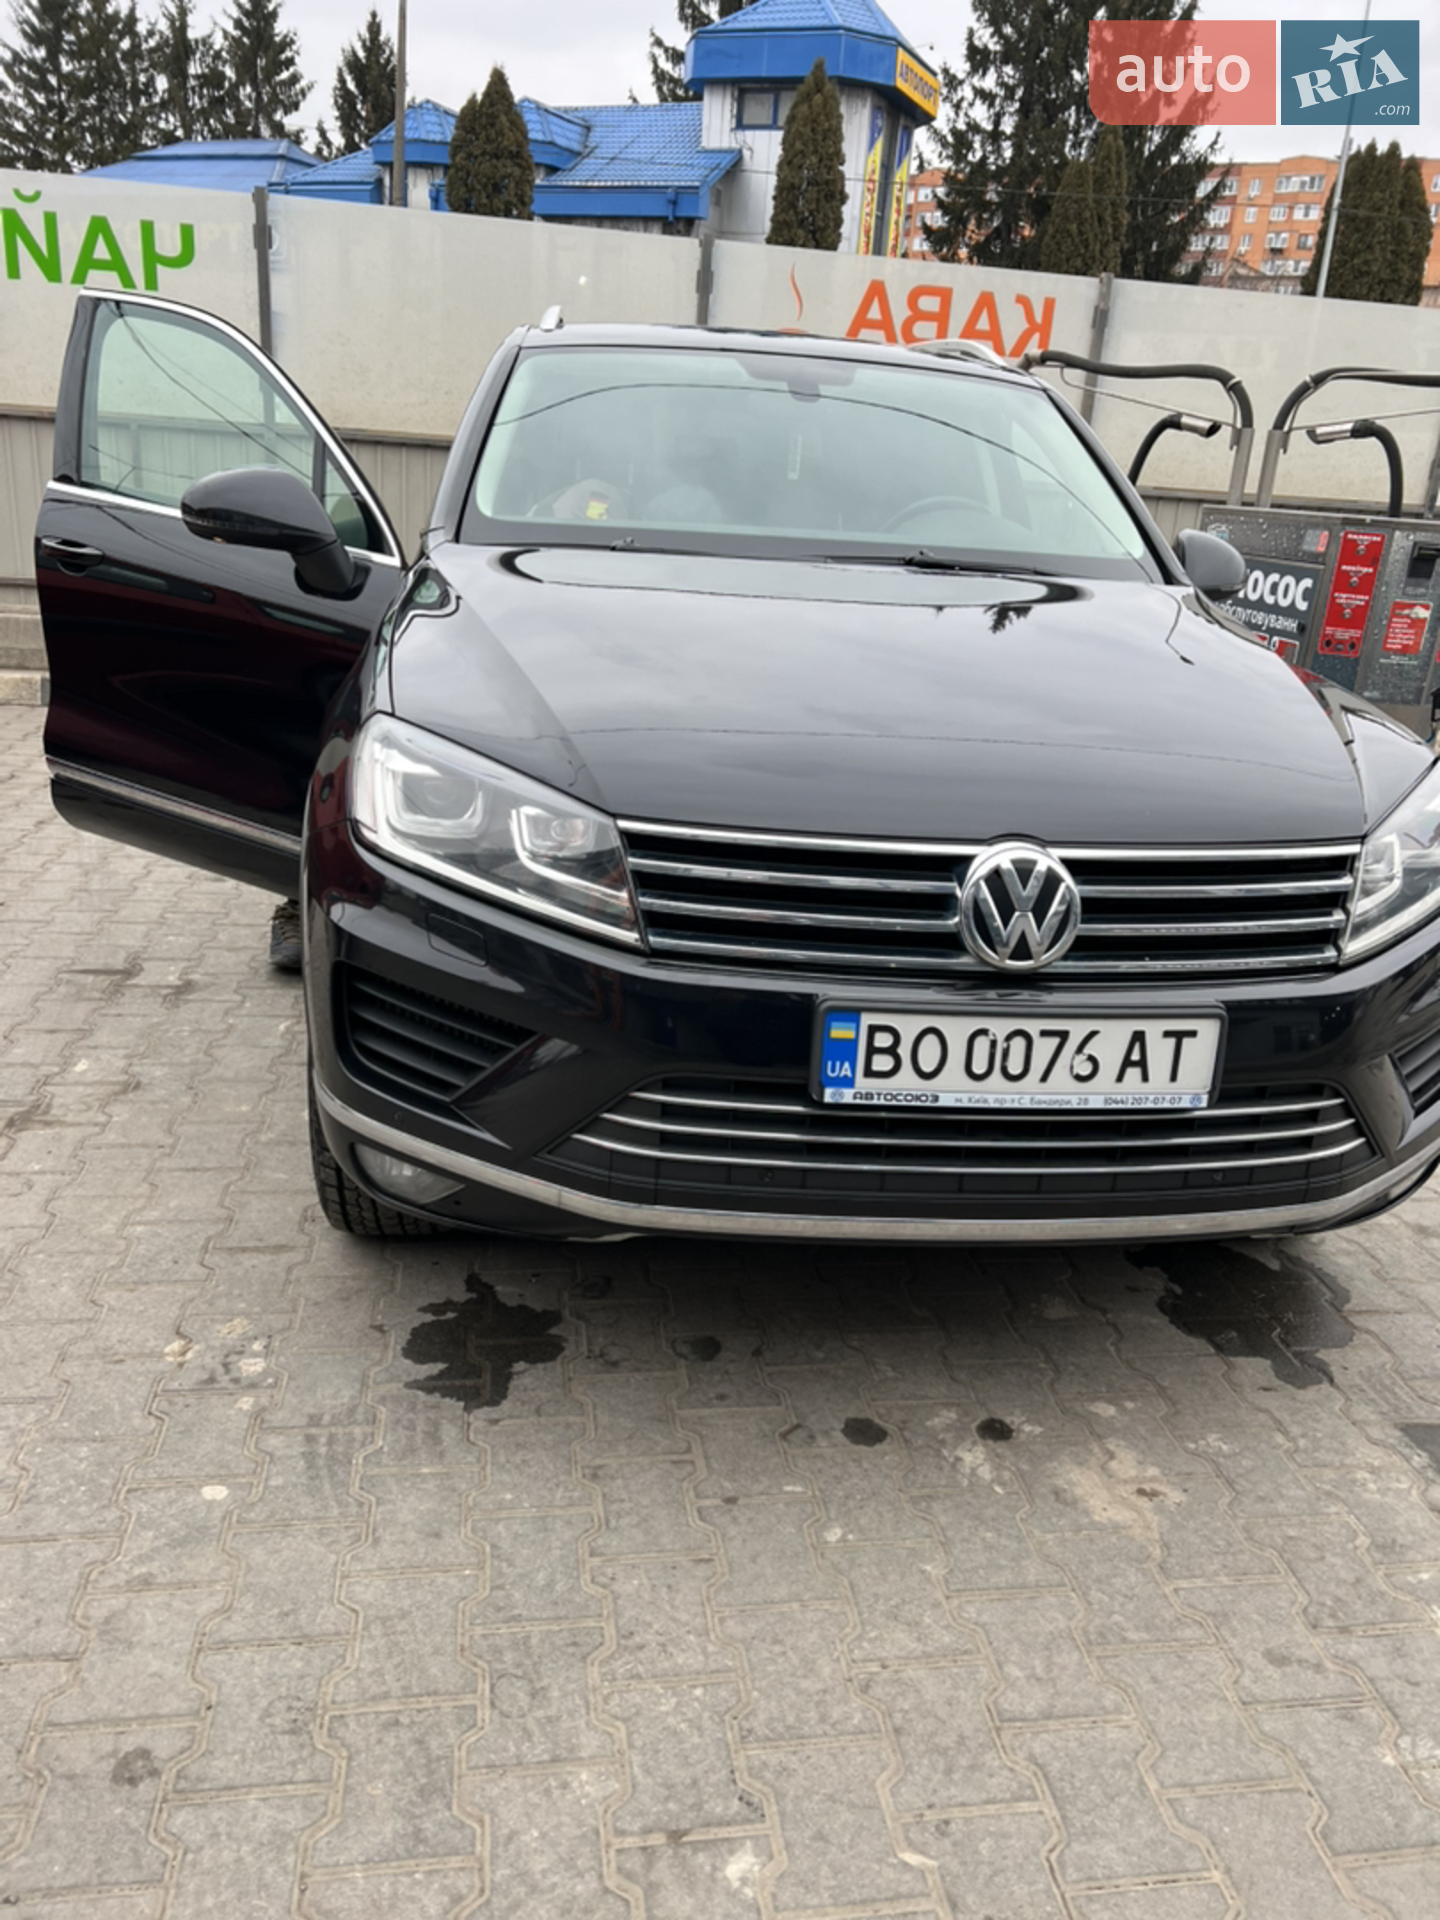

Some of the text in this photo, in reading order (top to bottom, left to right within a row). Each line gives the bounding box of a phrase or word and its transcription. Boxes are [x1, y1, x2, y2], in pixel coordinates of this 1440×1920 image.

[1238, 569, 1314, 612] ОСОС
[863, 1023, 1199, 1083] BO 0076 AT
[826, 1060, 853, 1079] UA
[852, 1091, 940, 1105] АВТОСОЮЗ
[1130, 1096, 1183, 1107] 207-07-07
